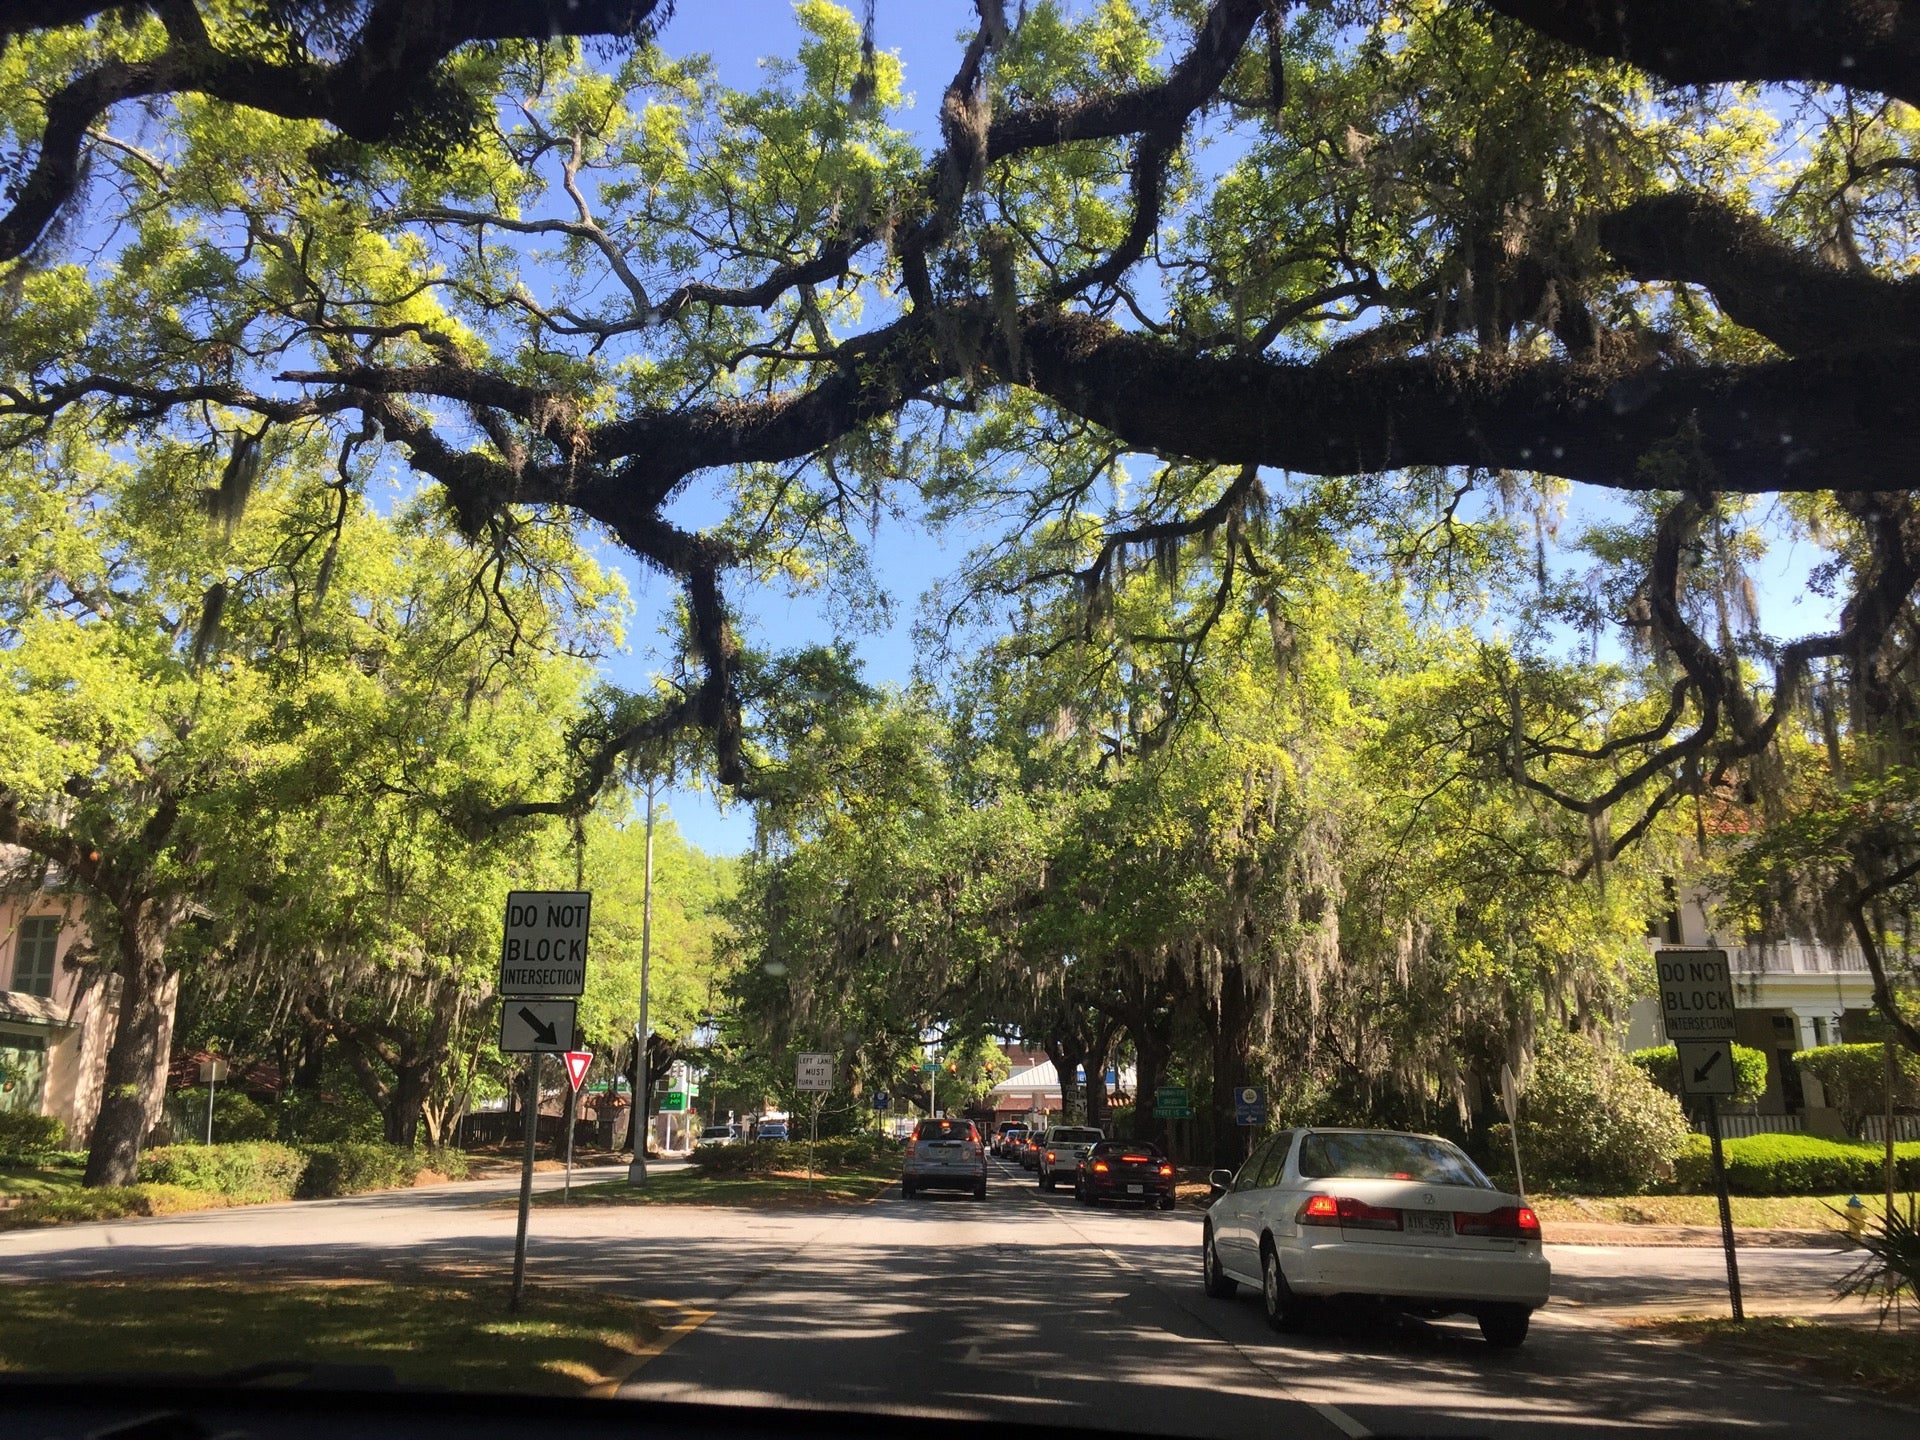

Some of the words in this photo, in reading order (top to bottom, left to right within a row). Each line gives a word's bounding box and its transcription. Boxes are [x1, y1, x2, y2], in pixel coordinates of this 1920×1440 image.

[510, 905, 537, 928] DO
[547, 905, 585, 928] NOT
[507, 938, 582, 962] BLOCK
[504, 969, 581, 985] INTERSECTION
[1661, 963, 1685, 982] DO
[1690, 963, 1725, 982] NOT
[1666, 991, 1731, 1011] BLOCK
[1669, 1016, 1734, 1031] INTERSECTION
[817, 1057, 832, 1065] LANE
[805, 1068, 825, 1076] MUST
